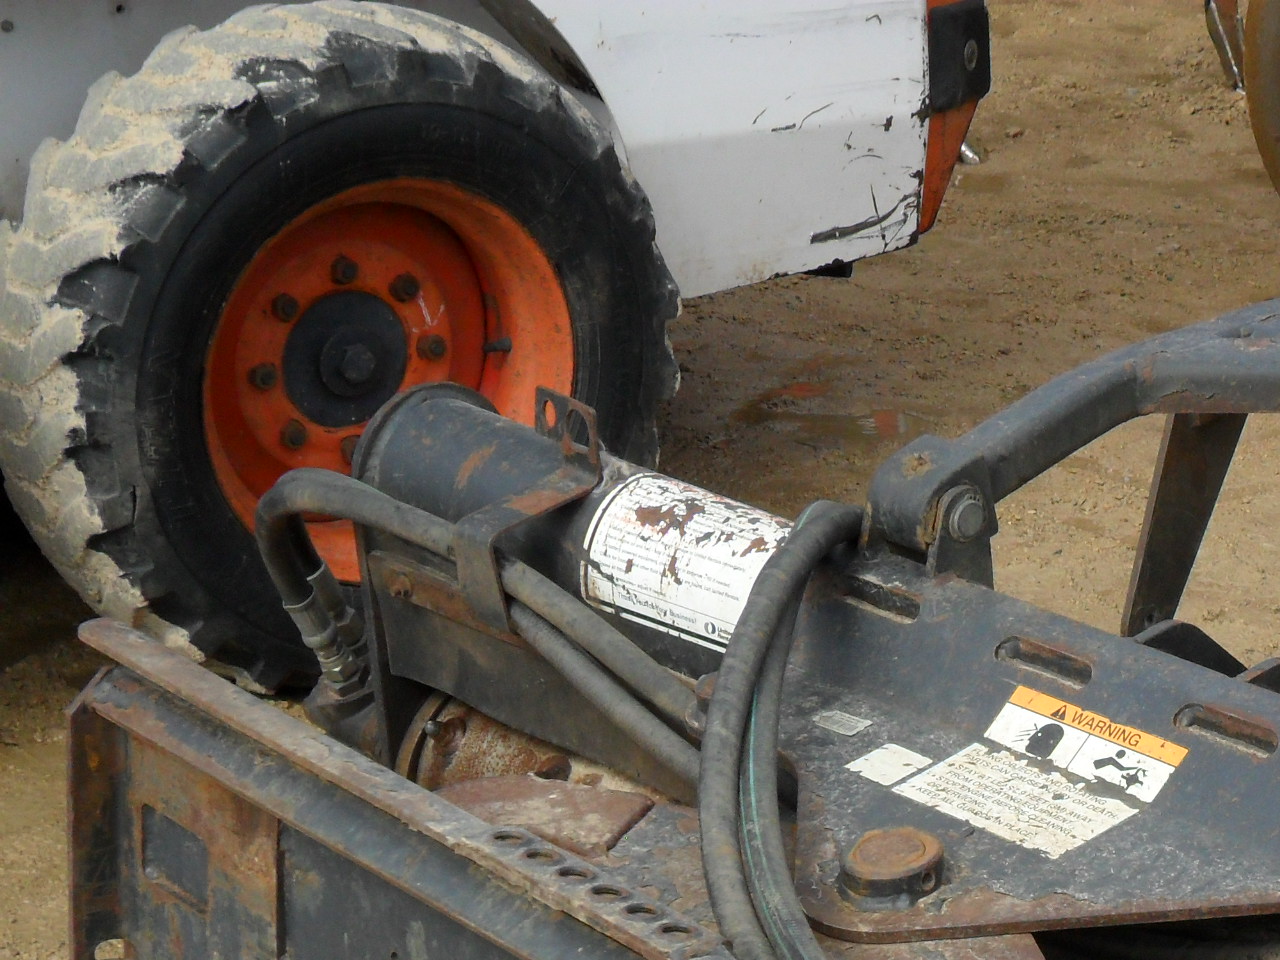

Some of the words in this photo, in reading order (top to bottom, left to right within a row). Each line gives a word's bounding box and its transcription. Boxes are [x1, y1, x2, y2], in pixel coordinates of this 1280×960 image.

[1071, 710, 1142, 747] WARNING
[946, 770, 973, 783] FROM
[971, 780, 1023, 803] OPERATING
[961, 753, 992, 767] PARTS
[990, 764, 1011, 775] CAN
[1010, 772, 1041, 787] CAUSE
[1072, 798, 1088, 806] OR
[1002, 760, 1043, 778] OBJECTS
[1042, 776, 1063, 787] AND
[916, 787, 941, 799] KEEP
[941, 796, 955, 805] ALL
[936, 775, 960, 788] STOP
[957, 784, 993, 801] ENGINE
[991, 798, 1029, 816] BEFORE
[1027, 813, 1073, 835] CLEANING
[955, 764, 980, 776] STAY
[1025, 793, 1050, 804] FEET
[1067, 811, 1093, 823] AWAY
